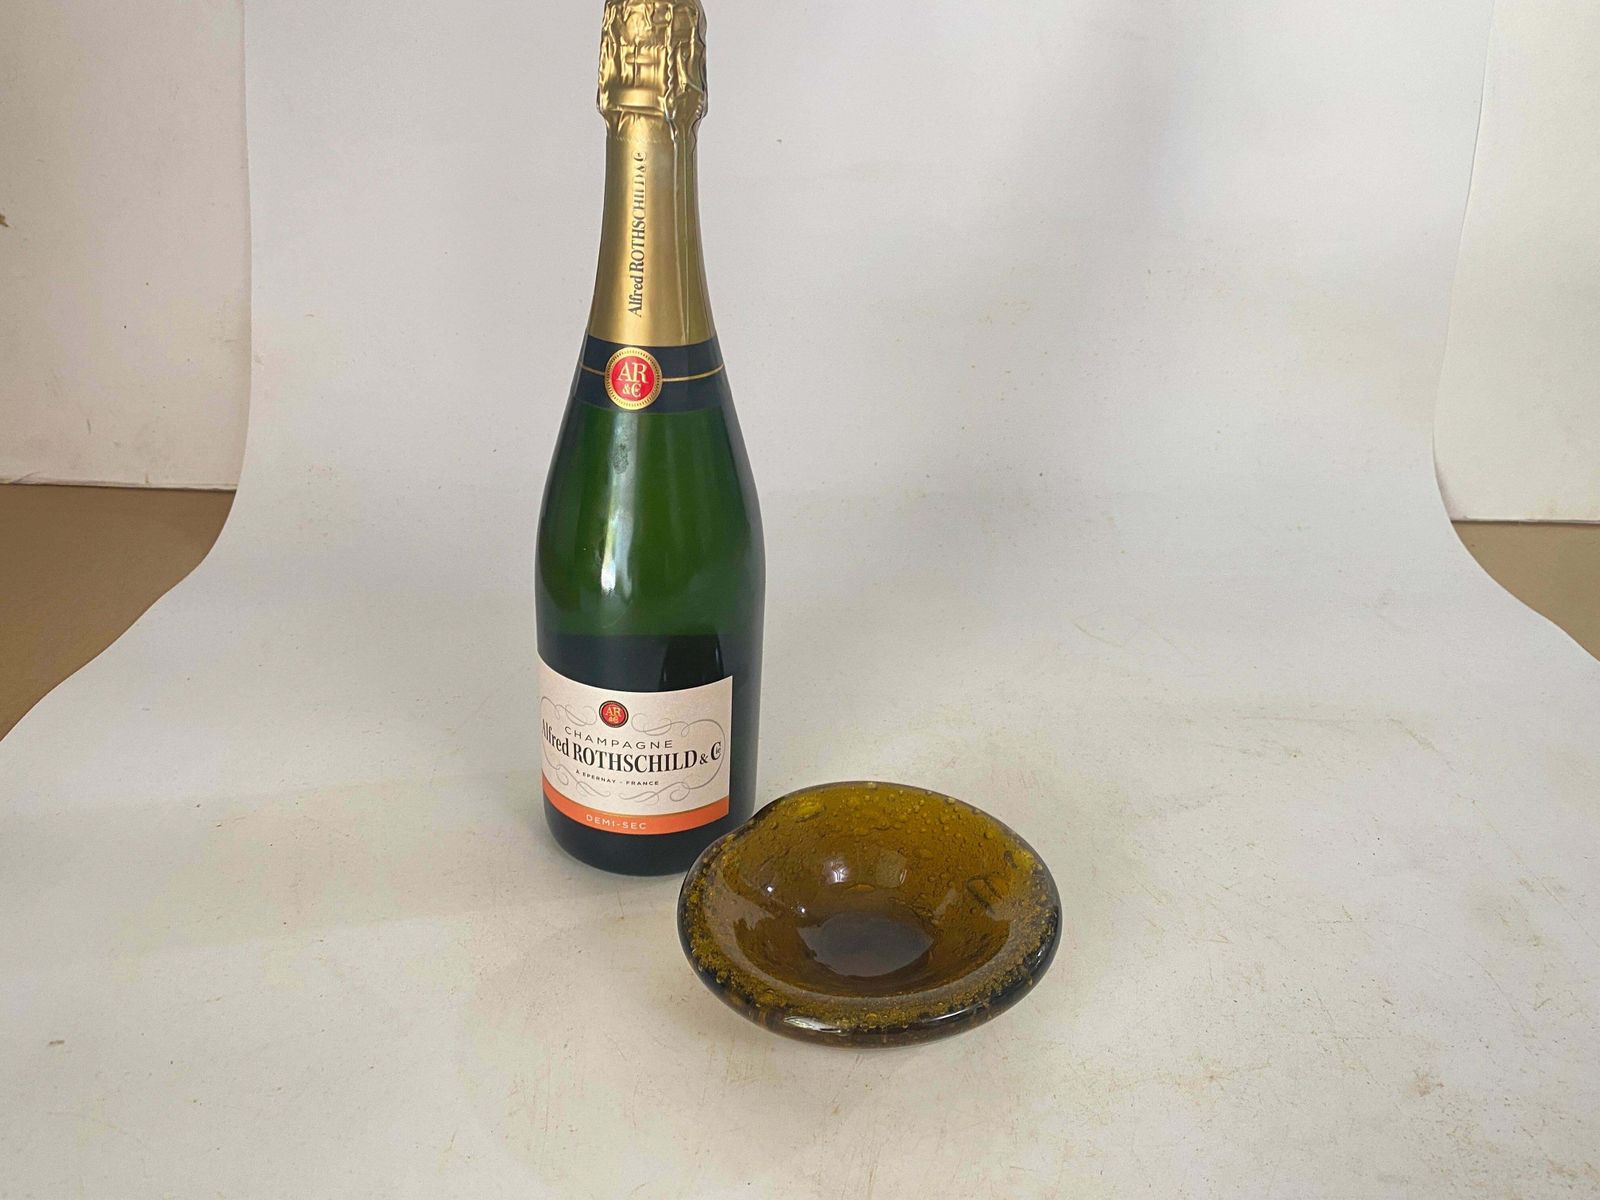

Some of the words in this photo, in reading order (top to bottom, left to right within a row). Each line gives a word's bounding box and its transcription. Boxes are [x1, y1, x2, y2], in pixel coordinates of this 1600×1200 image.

[628, 275, 643, 318] Alfred
[616, 361, 648, 384] AR
[605, 707, 621, 718] AR
[565, 727, 673, 749] CHAMPAGNE
[572, 743, 697, 773] ROTHSCHILD
[699, 753, 709, 765] &
[582, 772, 616, 784] EPERNAY
[586, 815, 648, 830] DEMI-SEC
